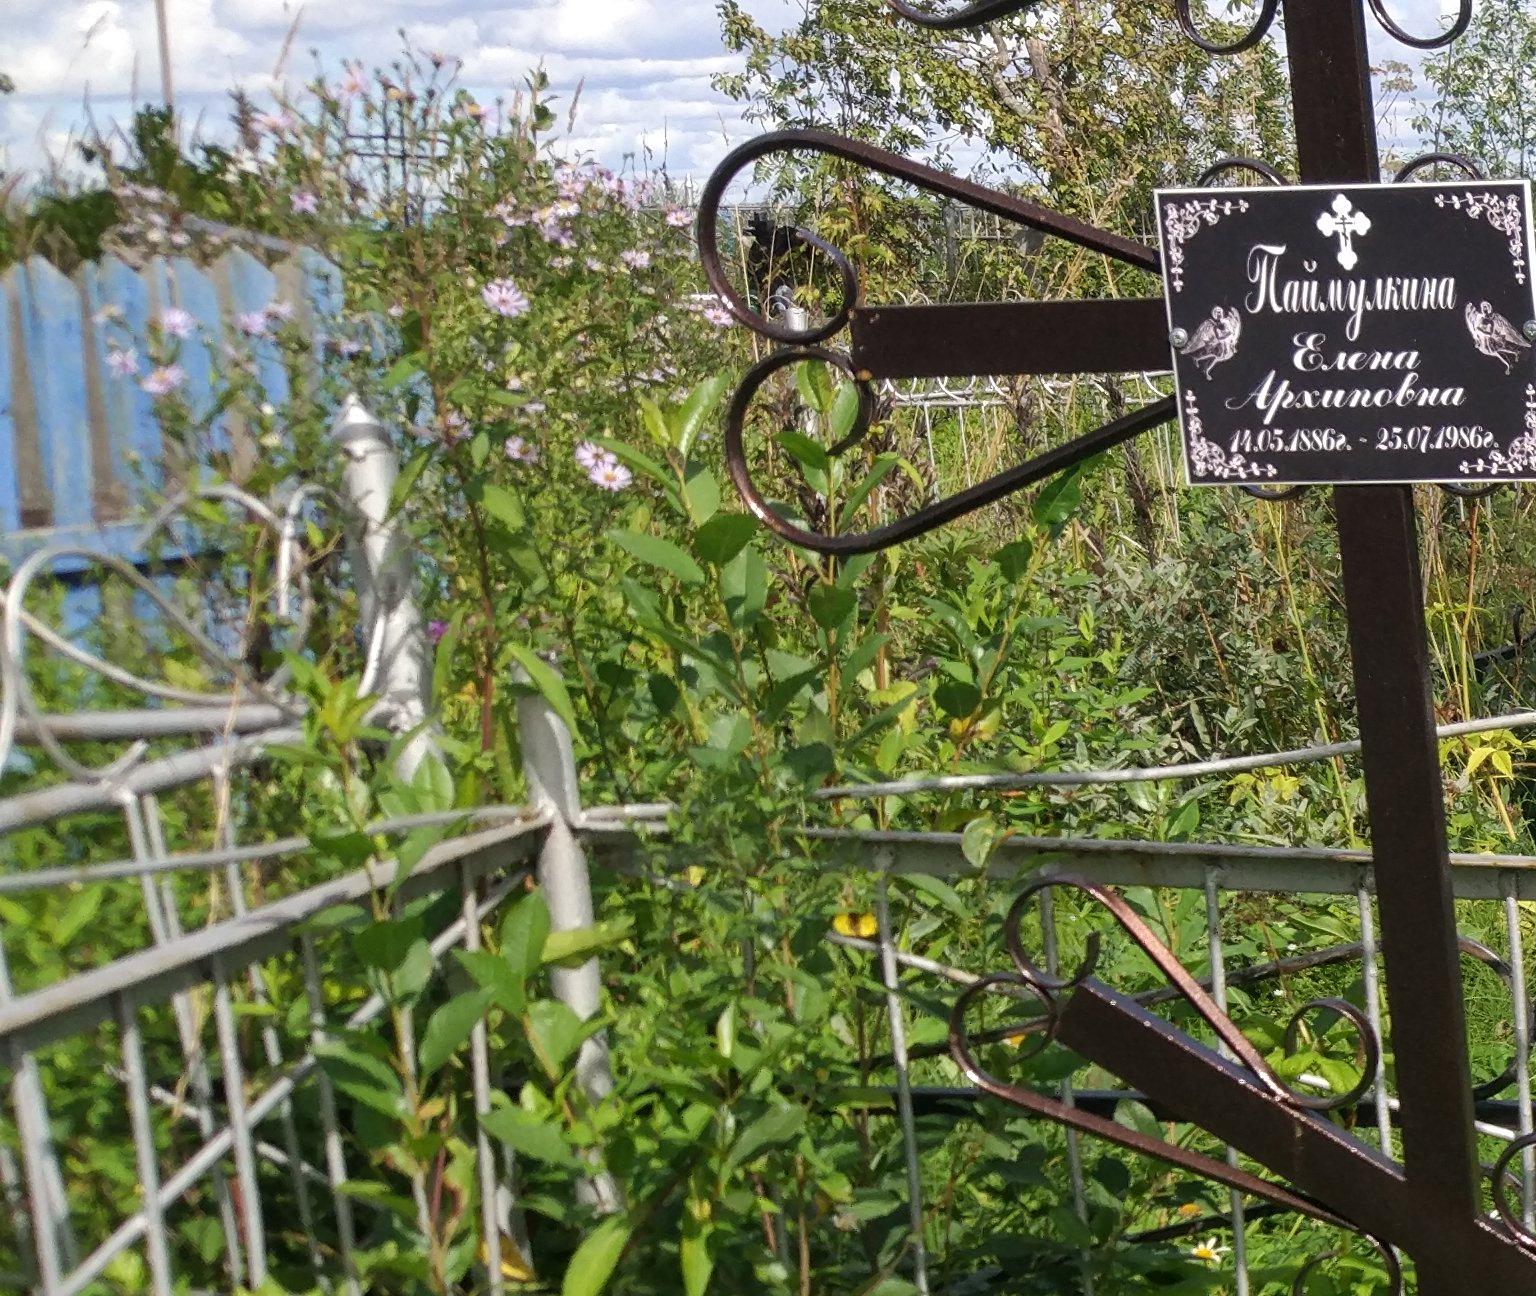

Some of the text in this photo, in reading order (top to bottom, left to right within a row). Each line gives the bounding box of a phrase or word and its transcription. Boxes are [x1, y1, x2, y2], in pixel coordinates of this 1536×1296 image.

[1245, 244, 1457, 342] Паймулкина
[1292, 332, 1422, 372] Елена
[1226, 369, 1469, 425] Архиповна
